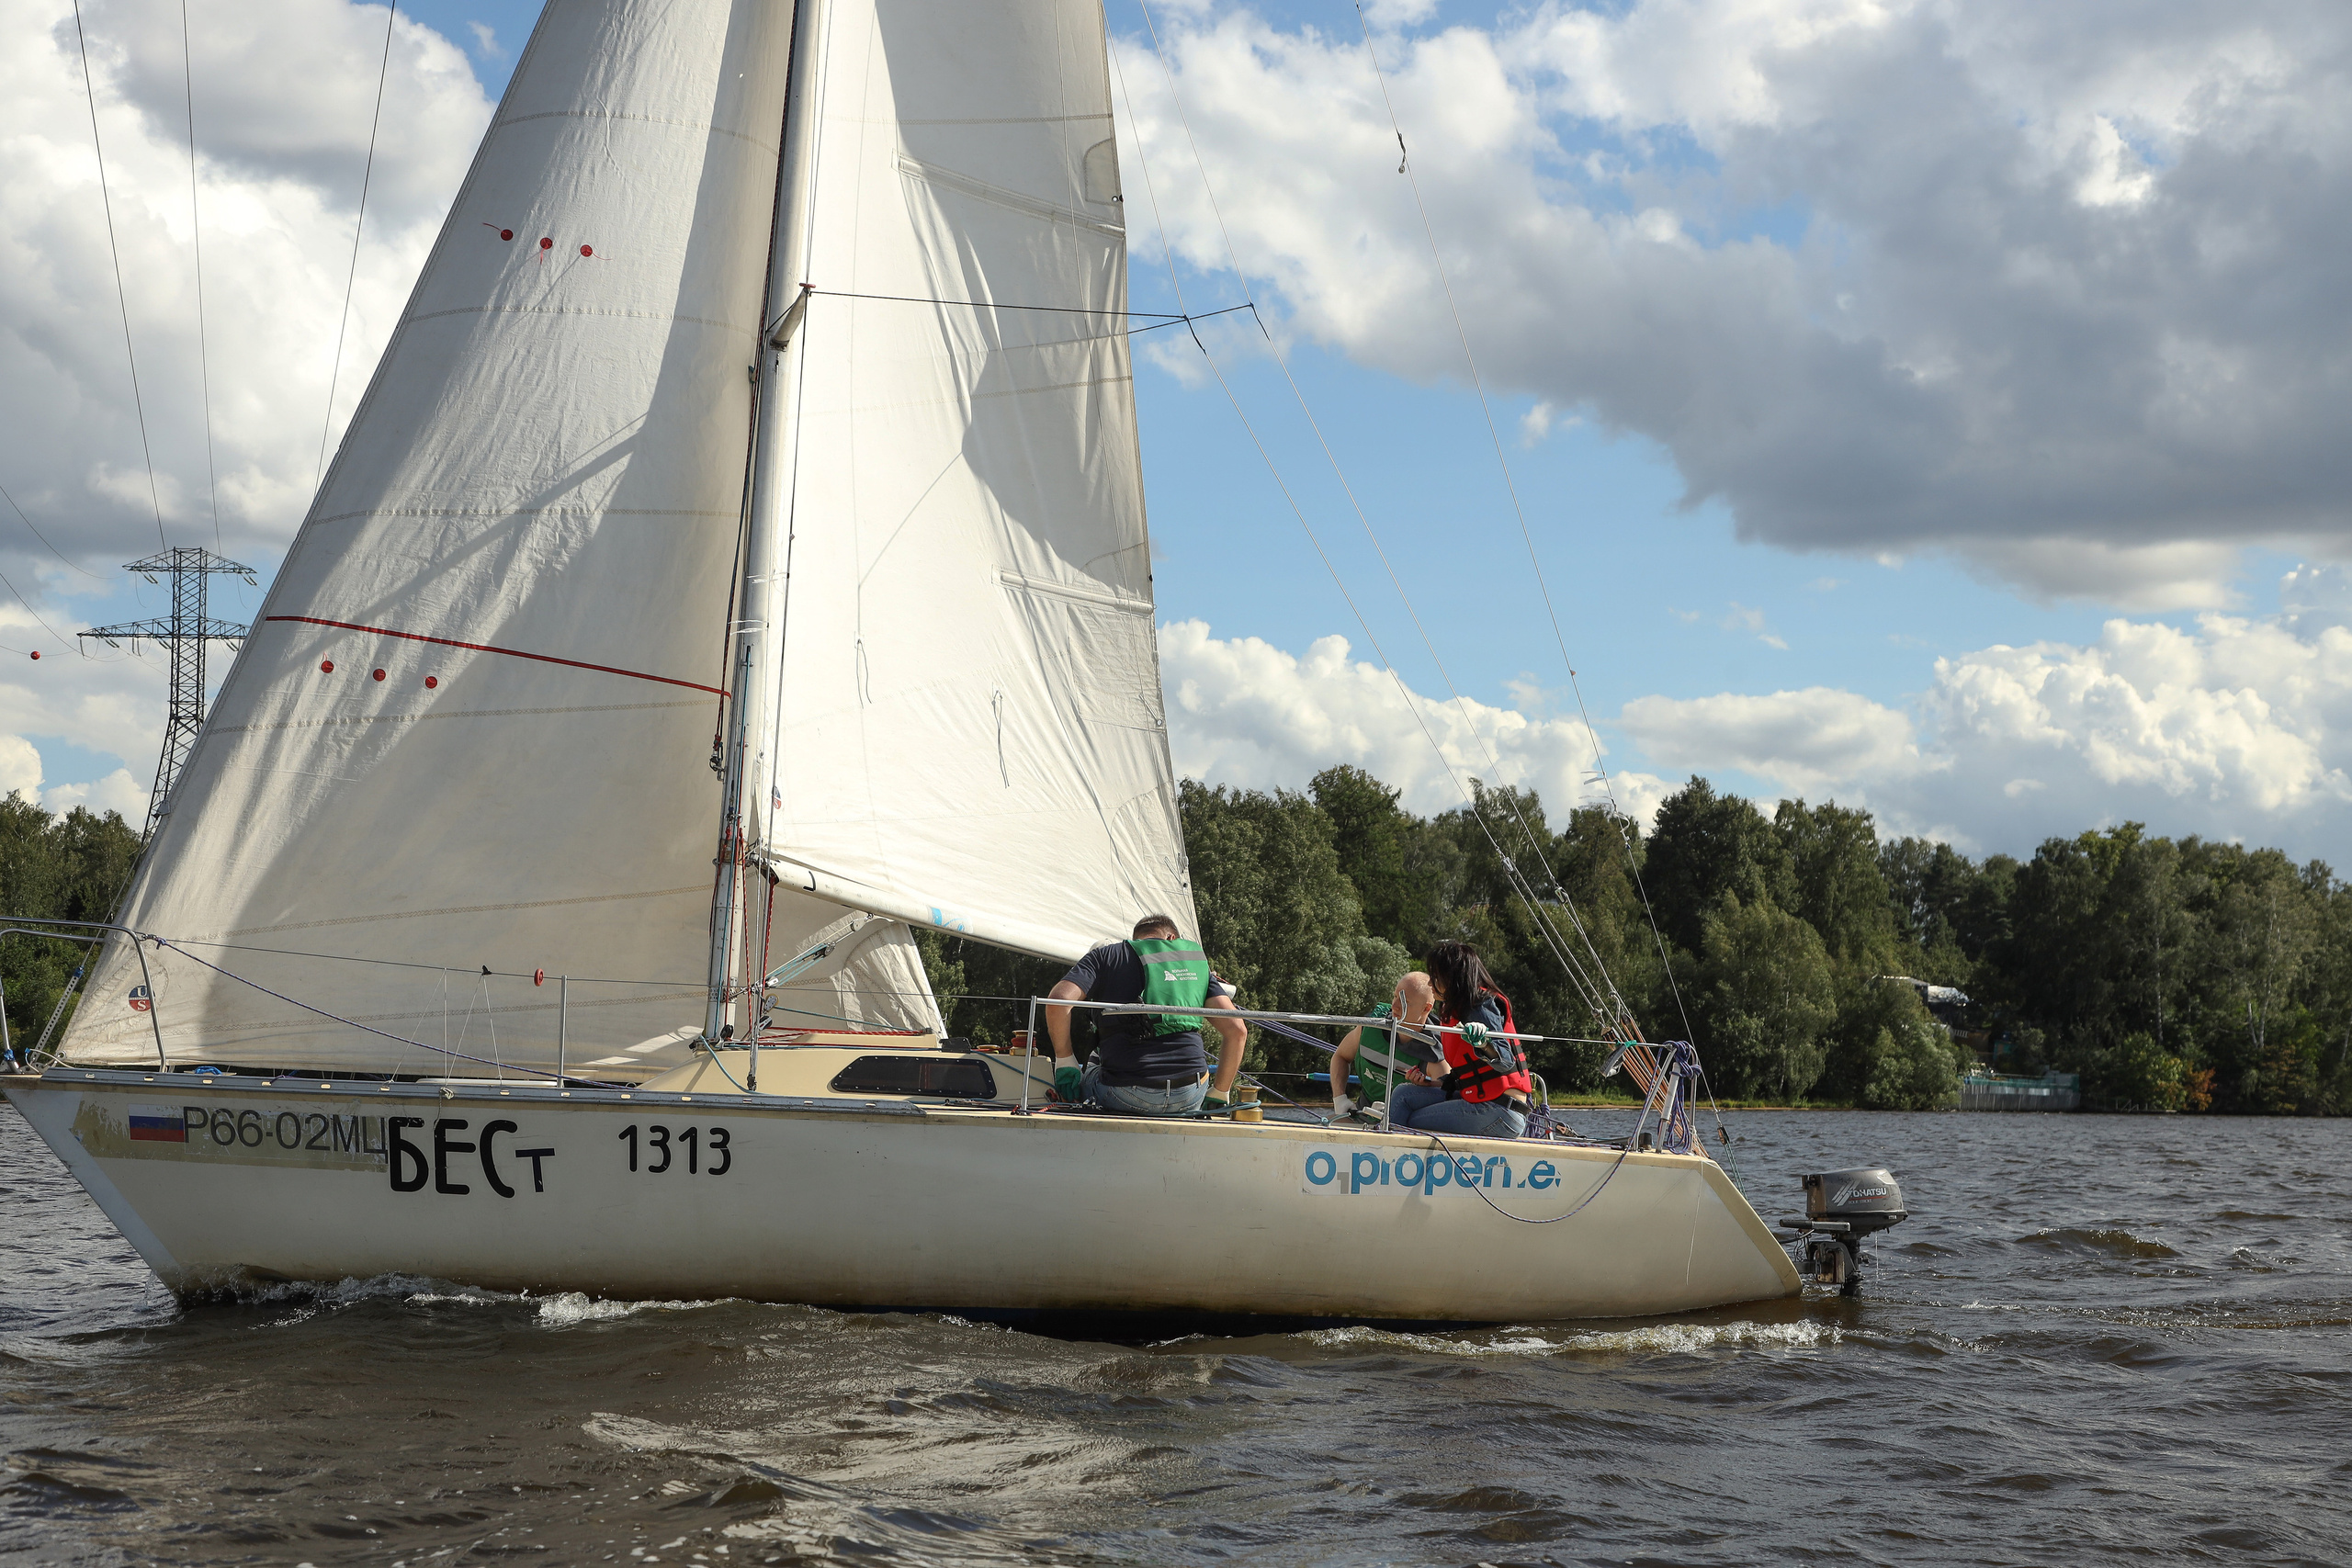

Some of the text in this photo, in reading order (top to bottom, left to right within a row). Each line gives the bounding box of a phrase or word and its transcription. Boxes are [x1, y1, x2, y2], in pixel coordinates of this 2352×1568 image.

[137, 1000, 147, 1010] S
[184, 1106, 388, 1164] Р66-02МЦ
[618, 1124, 731, 1175] 1313
